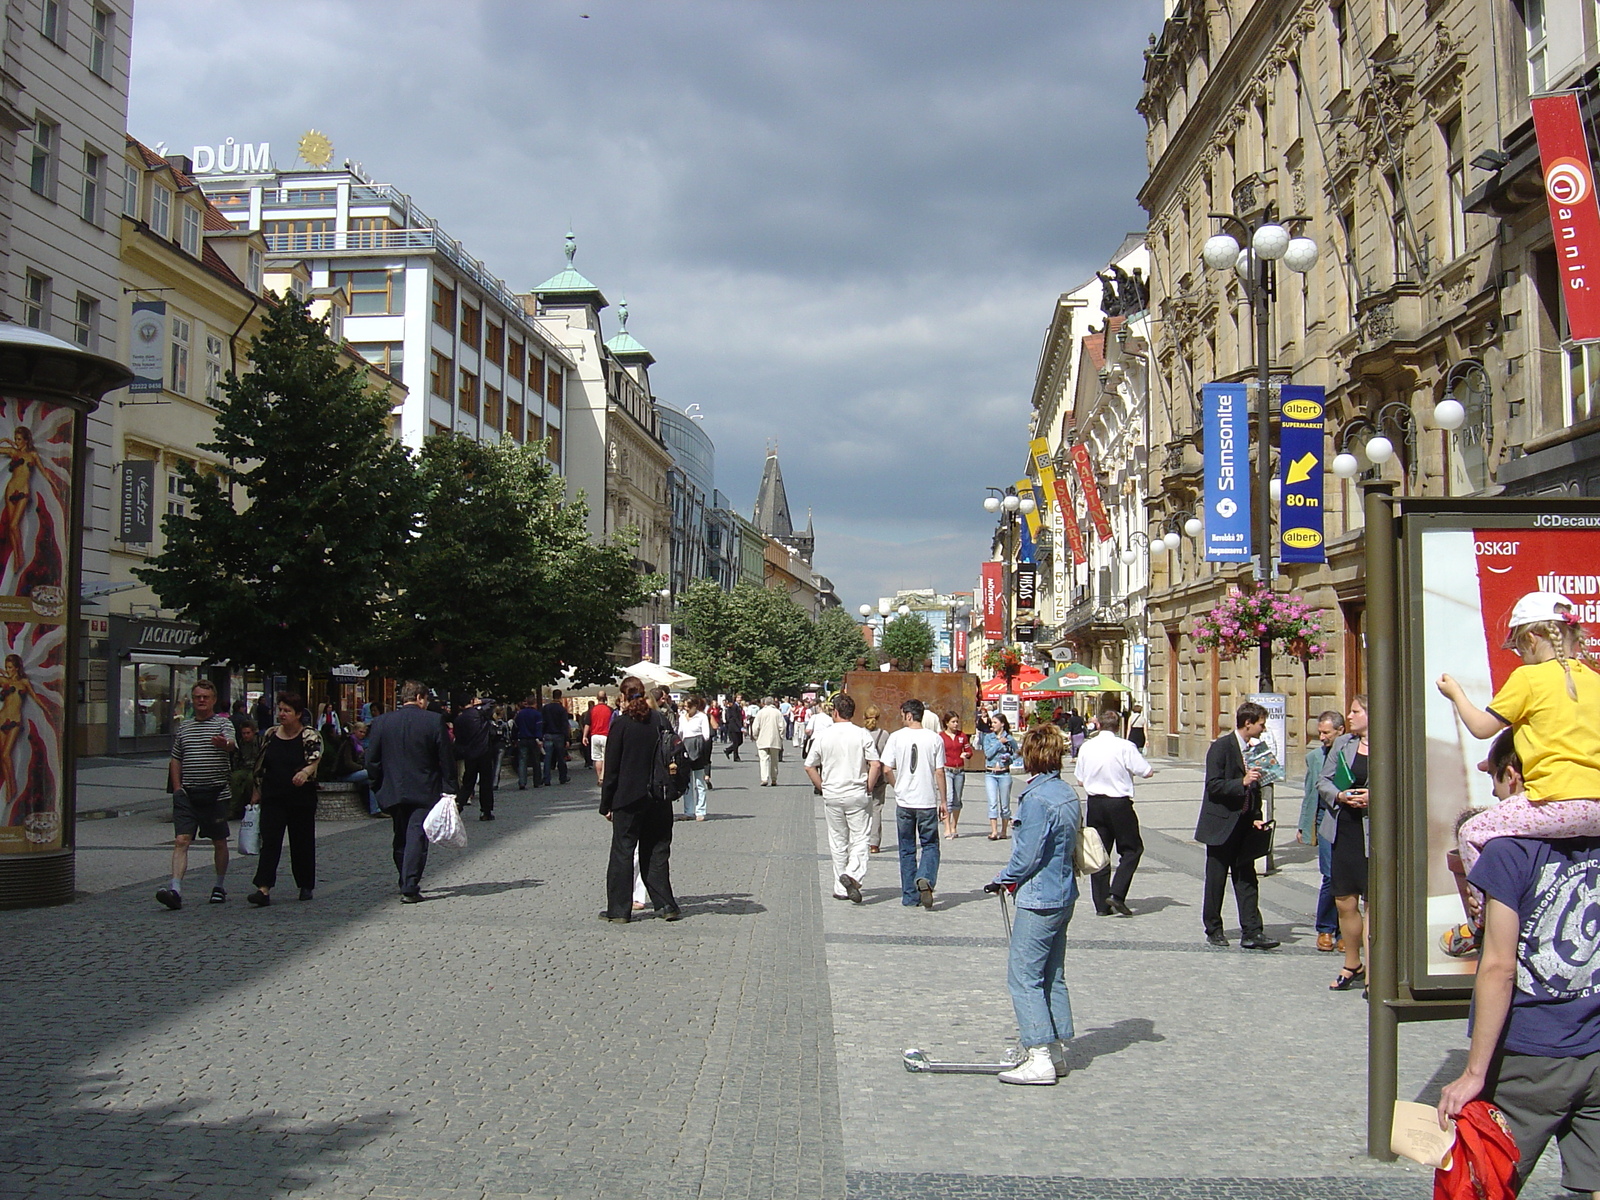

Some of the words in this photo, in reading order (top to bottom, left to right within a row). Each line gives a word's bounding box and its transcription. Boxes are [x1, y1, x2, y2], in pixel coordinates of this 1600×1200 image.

[192, 136, 270, 173] DŮM
[1286, 404, 1318, 414] albert
[1281, 421, 1324, 429] SUPERMARKET
[1217, 394, 1235, 491] Samsonite
[124, 468, 133, 534] COTTONFIELD
[1074, 450, 1110, 537] CASINO
[1286, 493, 1305, 507] 80
[1305, 498, 1319, 507] m
[1056, 484, 1084, 560] SAVARIN
[1532, 514, 1600, 528] JCDecaux
[1286, 532, 1318, 542] albert
